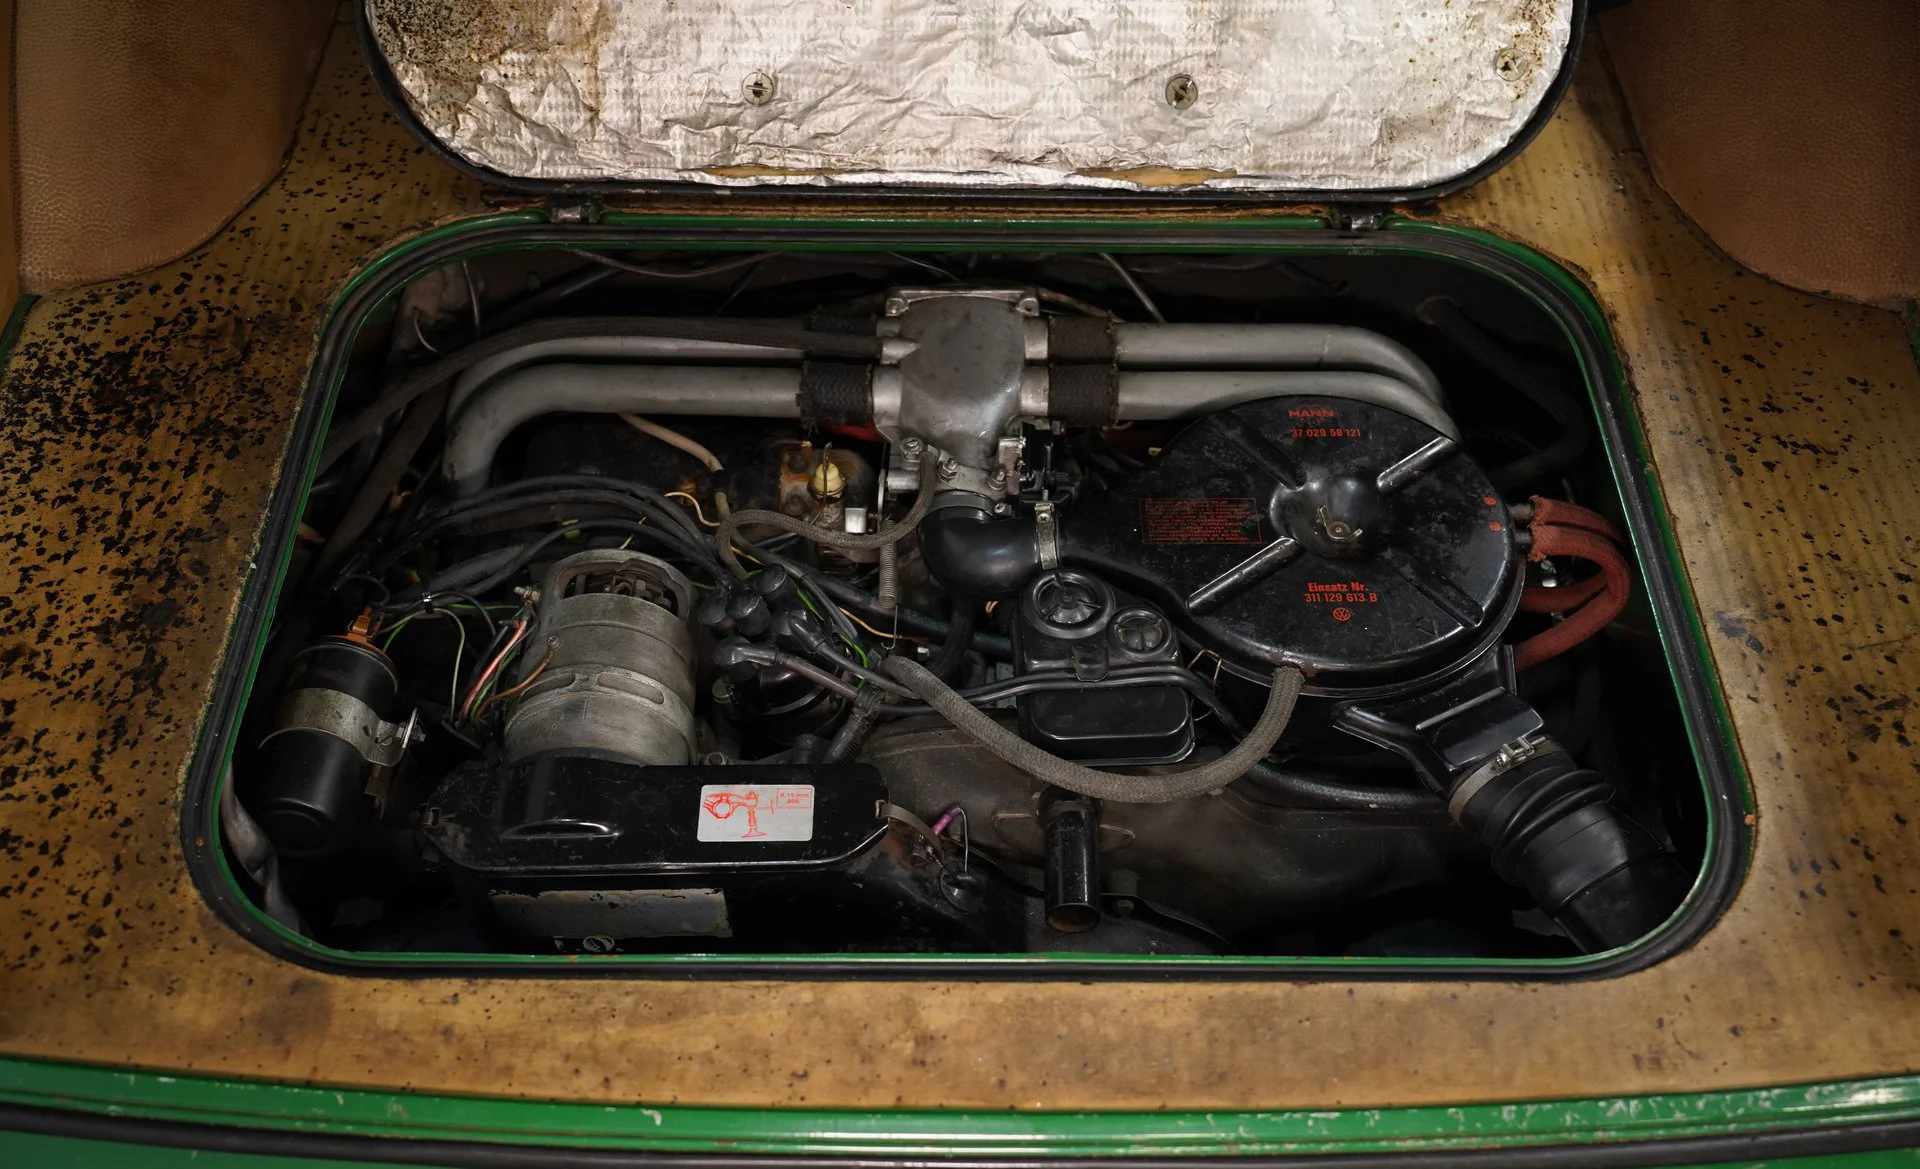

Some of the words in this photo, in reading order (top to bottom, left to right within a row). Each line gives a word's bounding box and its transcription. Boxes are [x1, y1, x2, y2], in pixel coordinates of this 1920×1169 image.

[1288, 409, 1334, 417] MANN
[1291, 428, 1303, 437] 37
[1306, 428, 1326, 437] 029
[1330, 428, 1343, 437] 58
[1345, 428, 1361, 437] 121
[1307, 582, 1348, 592] Einsatz
[1304, 593, 1321, 603] 311
[1323, 593, 1343, 603] 129
[1346, 593, 1365, 603] 613
[1369, 593, 1378, 603] B
